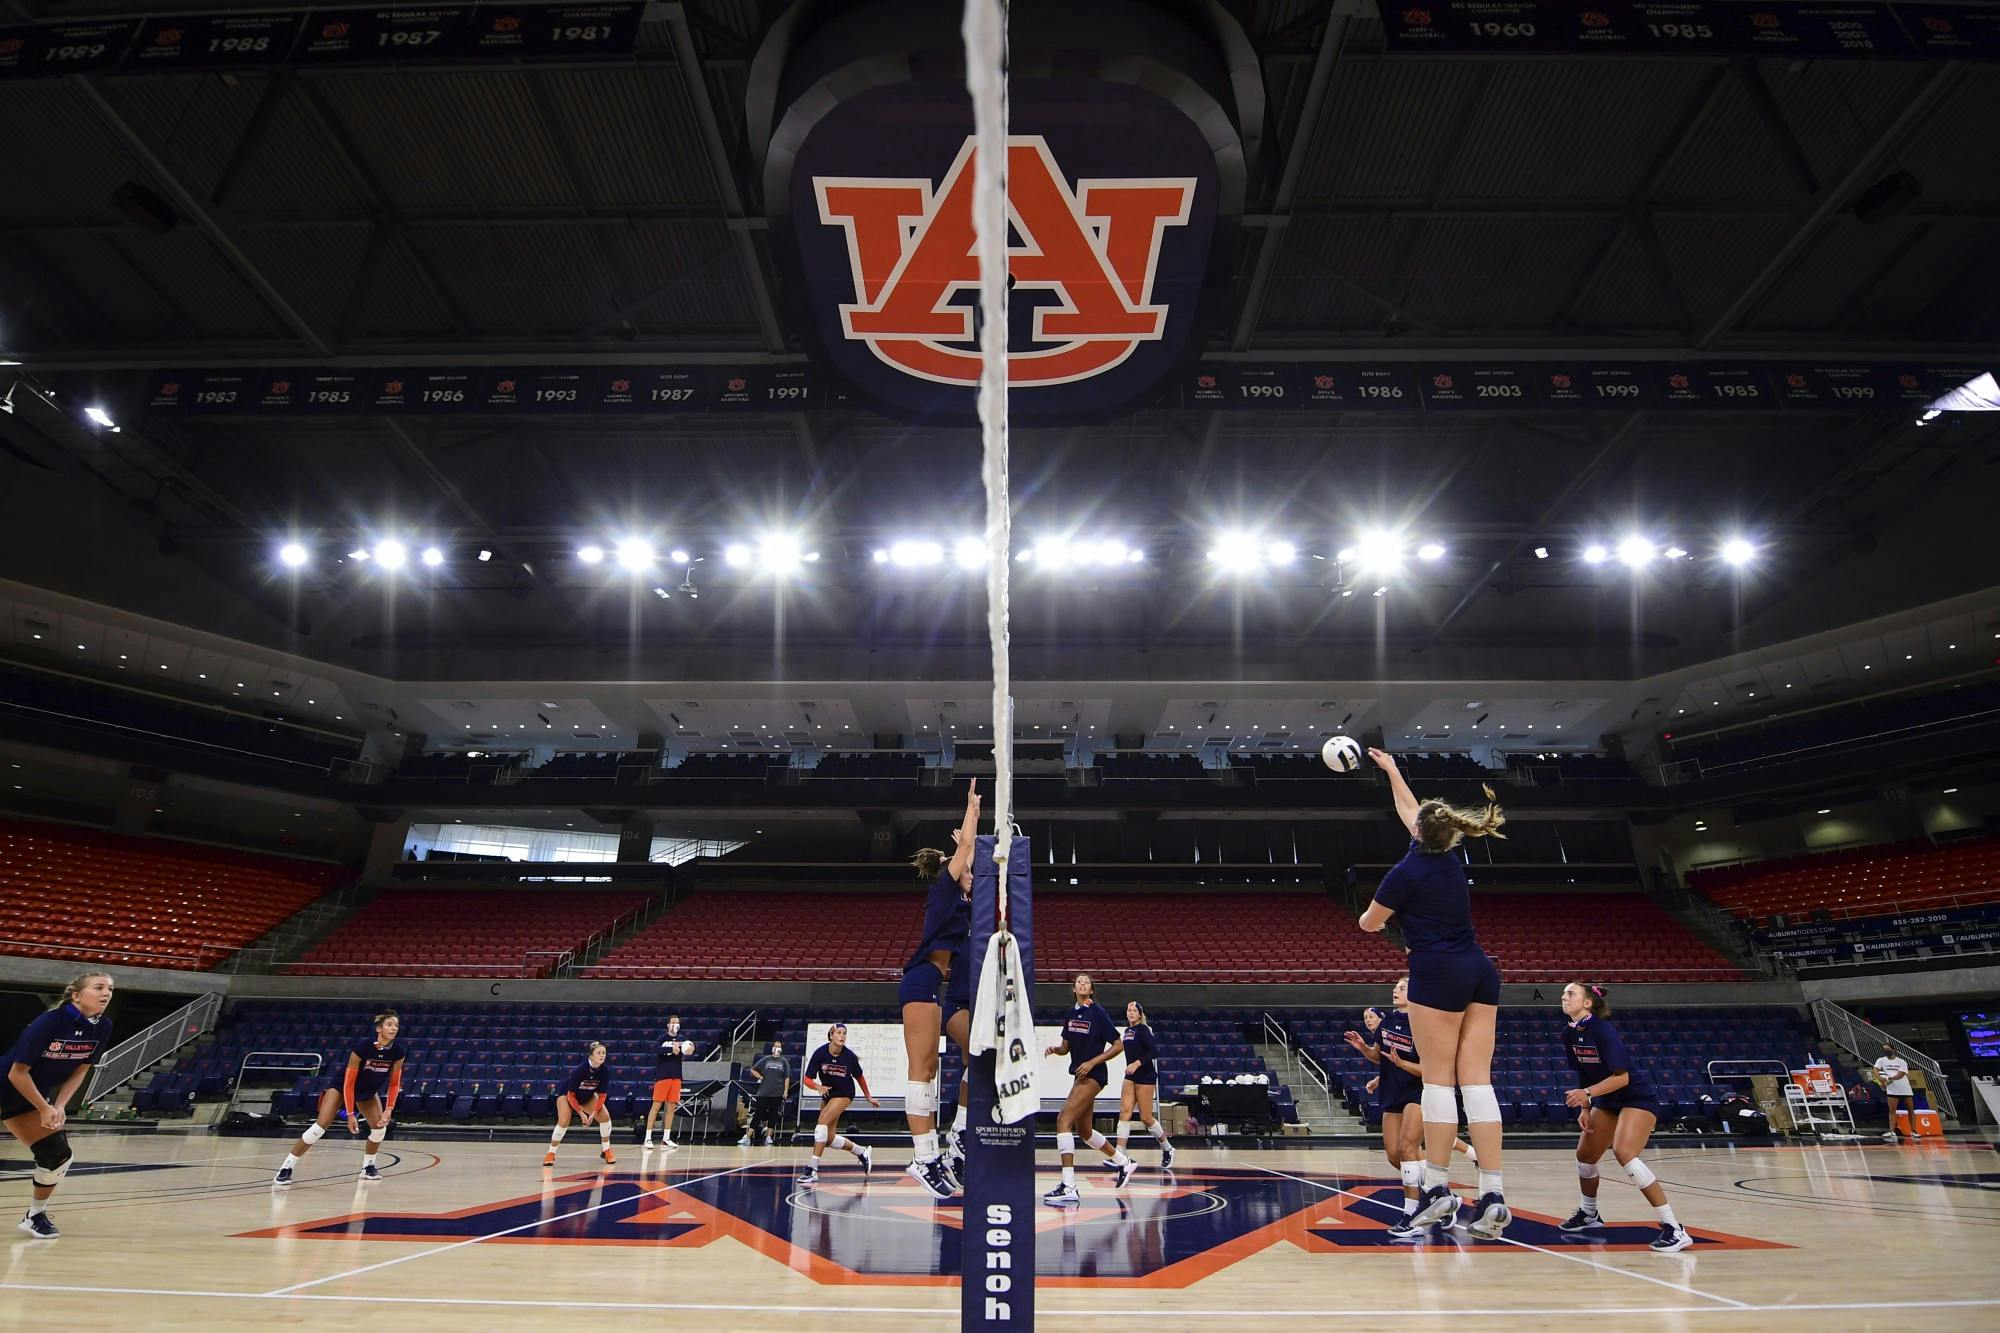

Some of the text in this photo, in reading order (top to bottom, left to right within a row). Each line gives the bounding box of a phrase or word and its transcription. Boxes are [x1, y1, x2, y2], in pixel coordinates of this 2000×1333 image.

[552, 26, 612, 41] 1981
[1469, 22, 1536, 37] 1960
[1647, 24, 1713, 38] 1985
[209, 37, 270, 52] 1988
[378, 31, 442, 46] 1987
[45, 44, 105, 60] 1989
[307, 391, 351, 403] 1985
[423, 390, 465, 402] 1986
[536, 390, 577, 402] 1993
[651, 389, 695, 401] 1987
[769, 387, 808, 399] 1991
[1240, 386, 1286, 398] 1990
[1358, 386, 1403, 398] 1986
[1476, 385, 1522, 397] 2003
[1596, 386, 1639, 397] 1999
[1714, 385, 1759, 397] 1985
[1832, 387, 1875, 399] 1999
[1893, 914, 1947, 926] 855-282-2010
[490, 983, 501, 995] C
[1533, 988, 1544, 1001] A
[976, 1126, 1026, 1136] SPORTS IMPORTS
[985, 1204, 1012, 1320] senoh
